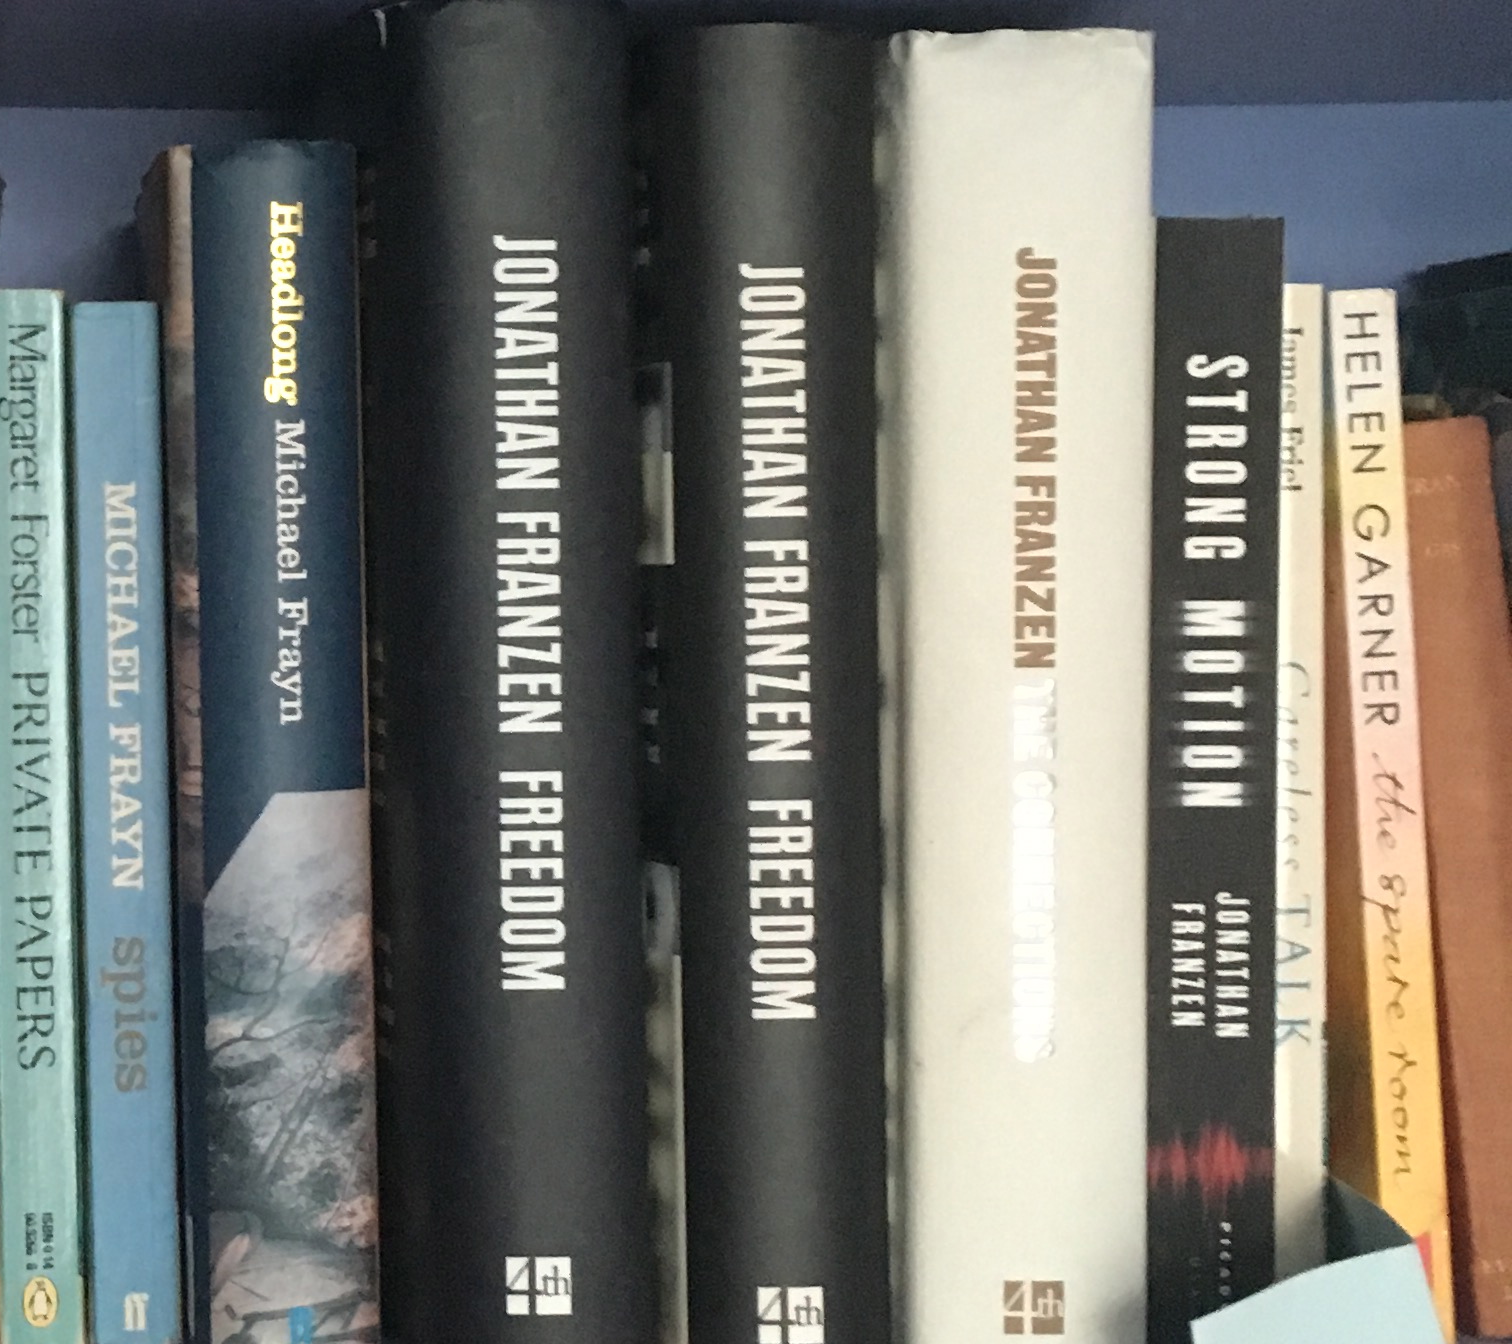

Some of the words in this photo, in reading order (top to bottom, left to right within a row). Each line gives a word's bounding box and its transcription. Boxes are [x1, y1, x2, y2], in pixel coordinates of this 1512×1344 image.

[264, 200, 305, 406] Headlong
[493, 235, 562, 490] JONATHAN
[1343, 312, 1389, 474] HELEN
[273, 419, 307, 582] Michael
[1181, 354, 1251, 560] STRONG
[11, 514, 50, 643] Forster
[104, 482, 145, 707] MICHAEL
[271, 596, 309, 725] Frayn
[497, 511, 564, 734] FRANZEN
[1352, 504, 1401, 726] GARNER
[11, 672, 53, 876] PRIVATE
[105, 723, 145, 890] FRAYN
[1182, 600, 1251, 808] MOTION
[15, 894, 57, 1071] PAPERS
[500, 770, 566, 991] FREEDOM
[100, 936, 158, 1094] spies
